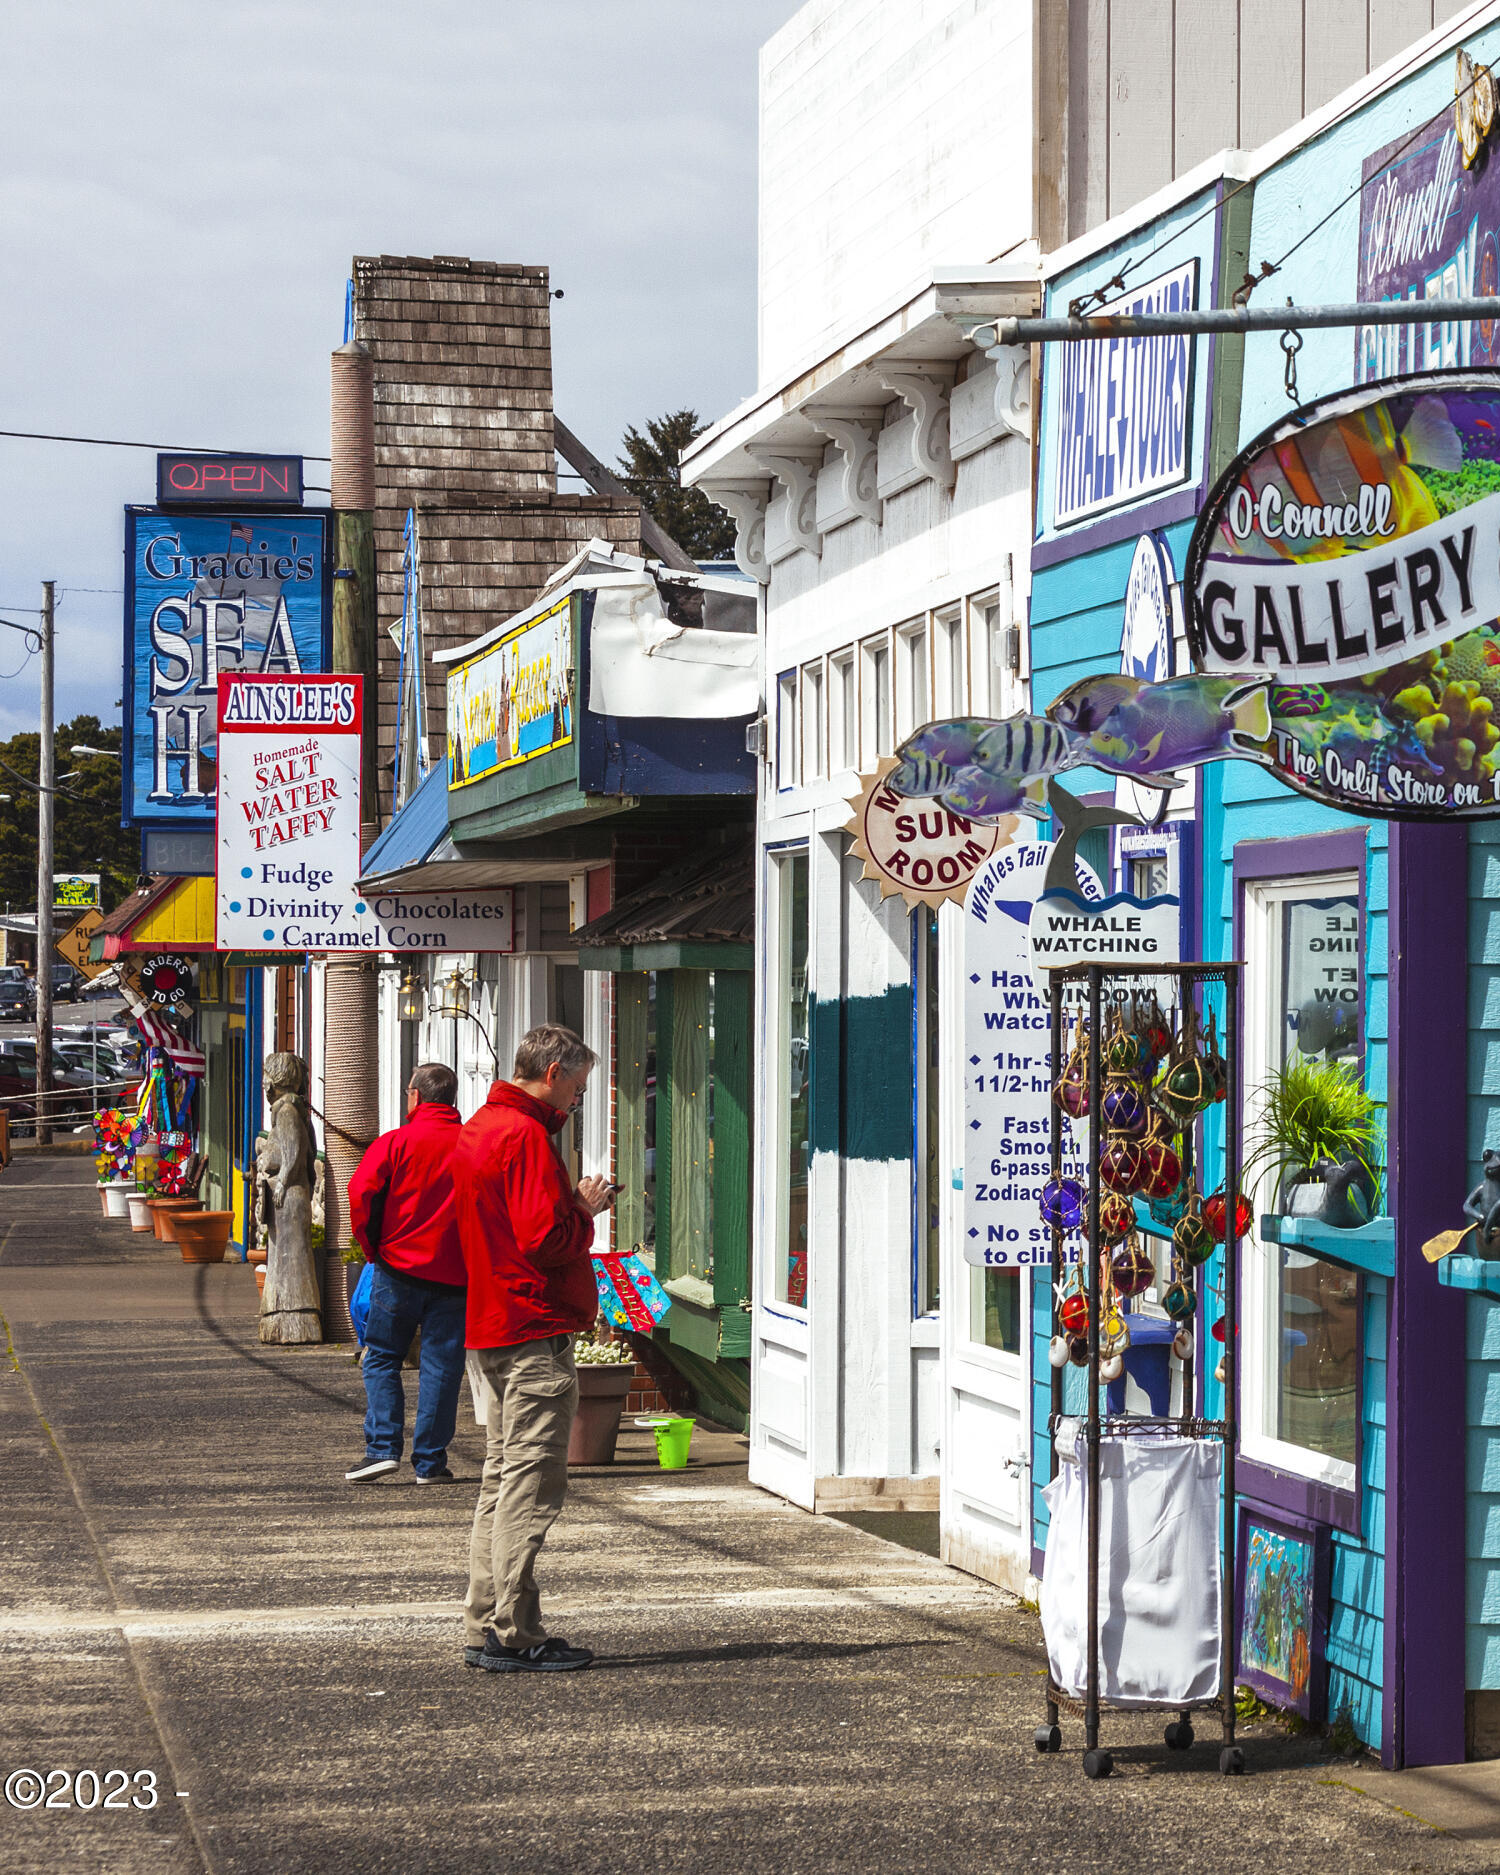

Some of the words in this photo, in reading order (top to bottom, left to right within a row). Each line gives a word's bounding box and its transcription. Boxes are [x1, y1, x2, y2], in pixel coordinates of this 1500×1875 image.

[1129, 273, 1192, 488] TOURS
[169, 463, 289, 493] OPEN
[1228, 482, 1397, 540] O'Connell
[145, 532, 315, 582] Gracie's
[1202, 524, 1478, 668] GALLERY
[150, 590, 302, 697] SEA
[224, 683, 354, 724] AINSLEE'S
[253, 738, 319, 767] Homemade
[1271, 728, 1320, 779] The
[1324, 748, 1379, 802] Only
[1387, 766, 1448, 805] Store
[1453, 782, 1483, 805] on
[255, 752, 322, 792] SALT
[240, 777, 342, 825] WATER
[249, 806, 336, 852] TAFFY
[895, 811, 972, 843] SUN
[260, 862, 334, 892] Fudge
[885, 839, 987, 885] ROOM
[971, 855, 1014, 924] Whales
[1017, 845, 1048, 868] Tail
[246, 897, 344, 925] Divinity
[374, 897, 504, 920] Chocolates
[1047, 916, 1142, 932] WHALE
[282, 925, 381, 947] Caramel
[387, 926, 448, 947] Corn
[1031, 937, 1159, 953] WATCHING
[142, 955, 188, 976] ORDERS
[991, 970, 1035, 988] Hav
[152, 990, 166, 1003] TO
[170, 988, 185, 1002] GO
[1003, 1116, 1050, 1134] Fast
[987, 1224, 1020, 1242] No
[983, 1247, 1008, 1264] to
[607, 1261, 652, 1329] OPEN
